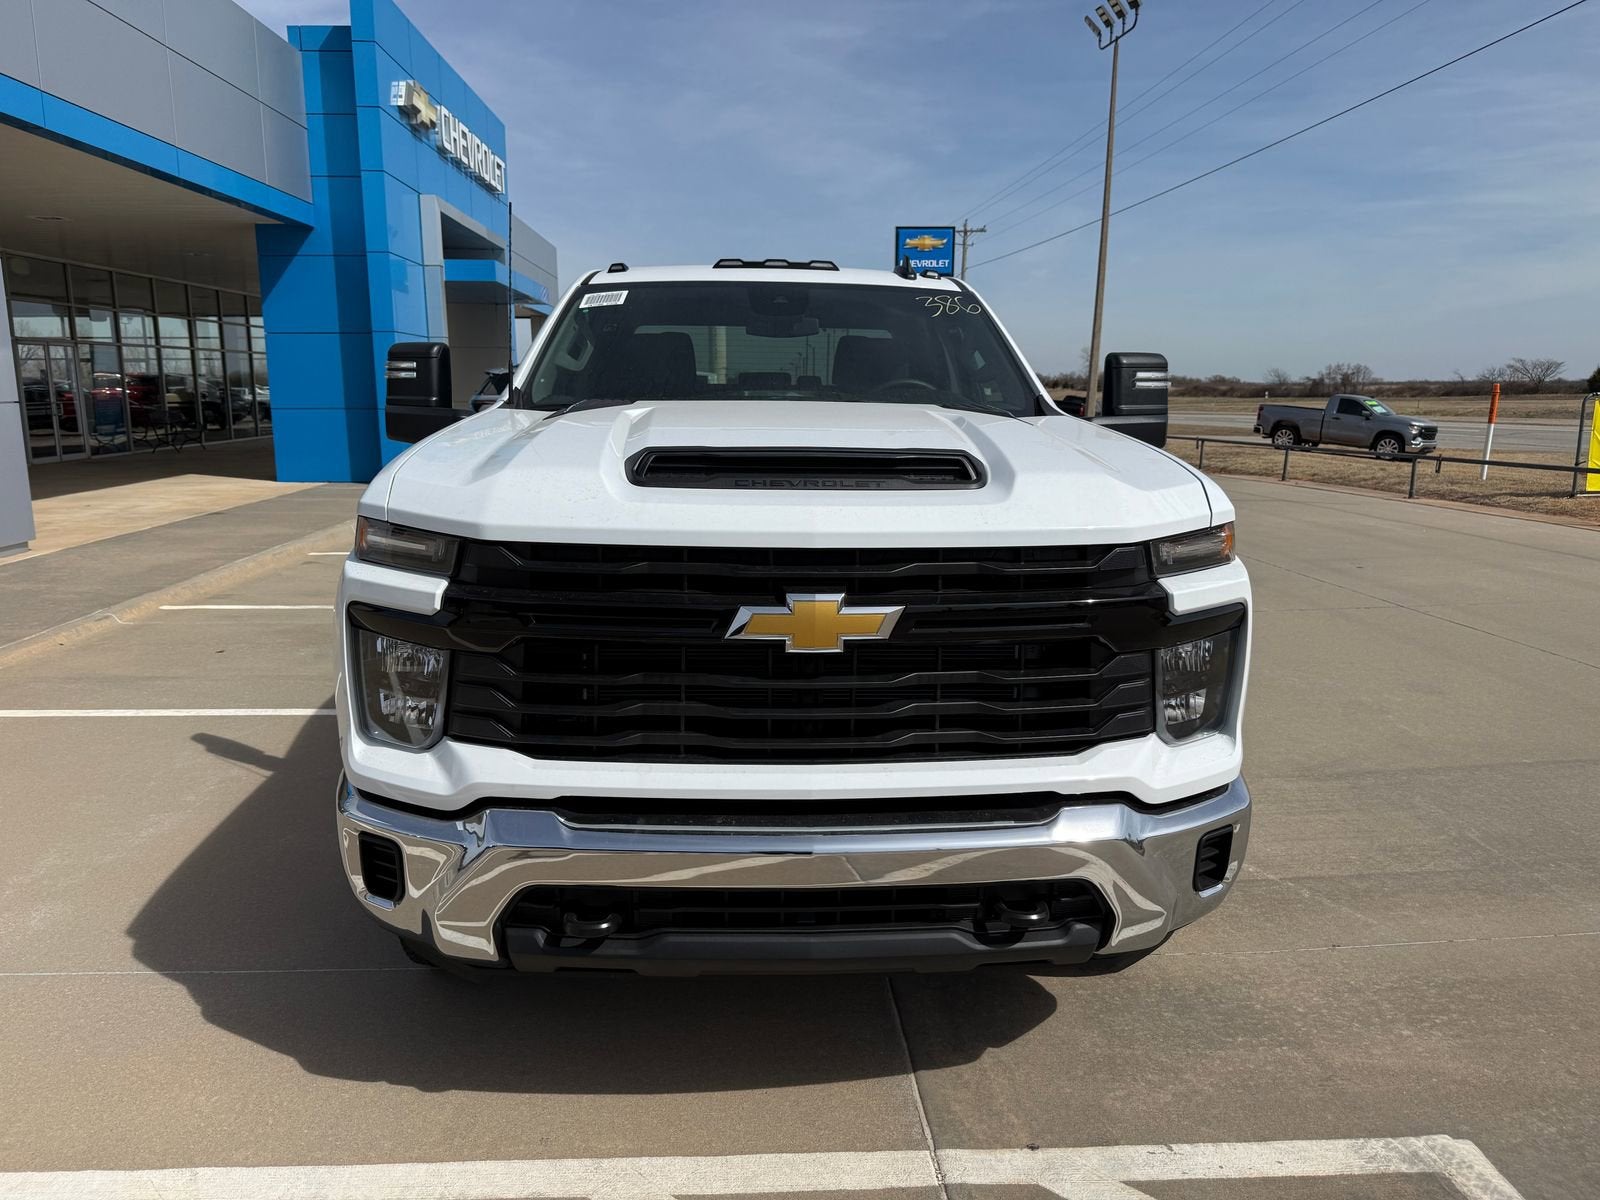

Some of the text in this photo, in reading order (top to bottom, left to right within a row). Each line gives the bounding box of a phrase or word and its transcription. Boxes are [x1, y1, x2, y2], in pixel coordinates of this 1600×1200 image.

[438, 104, 505, 194] CHEVROLET
[900, 259, 949, 268] EVROLET
[915, 295, 981, 317] 386
[734, 479, 886, 488] CHEVROLET
